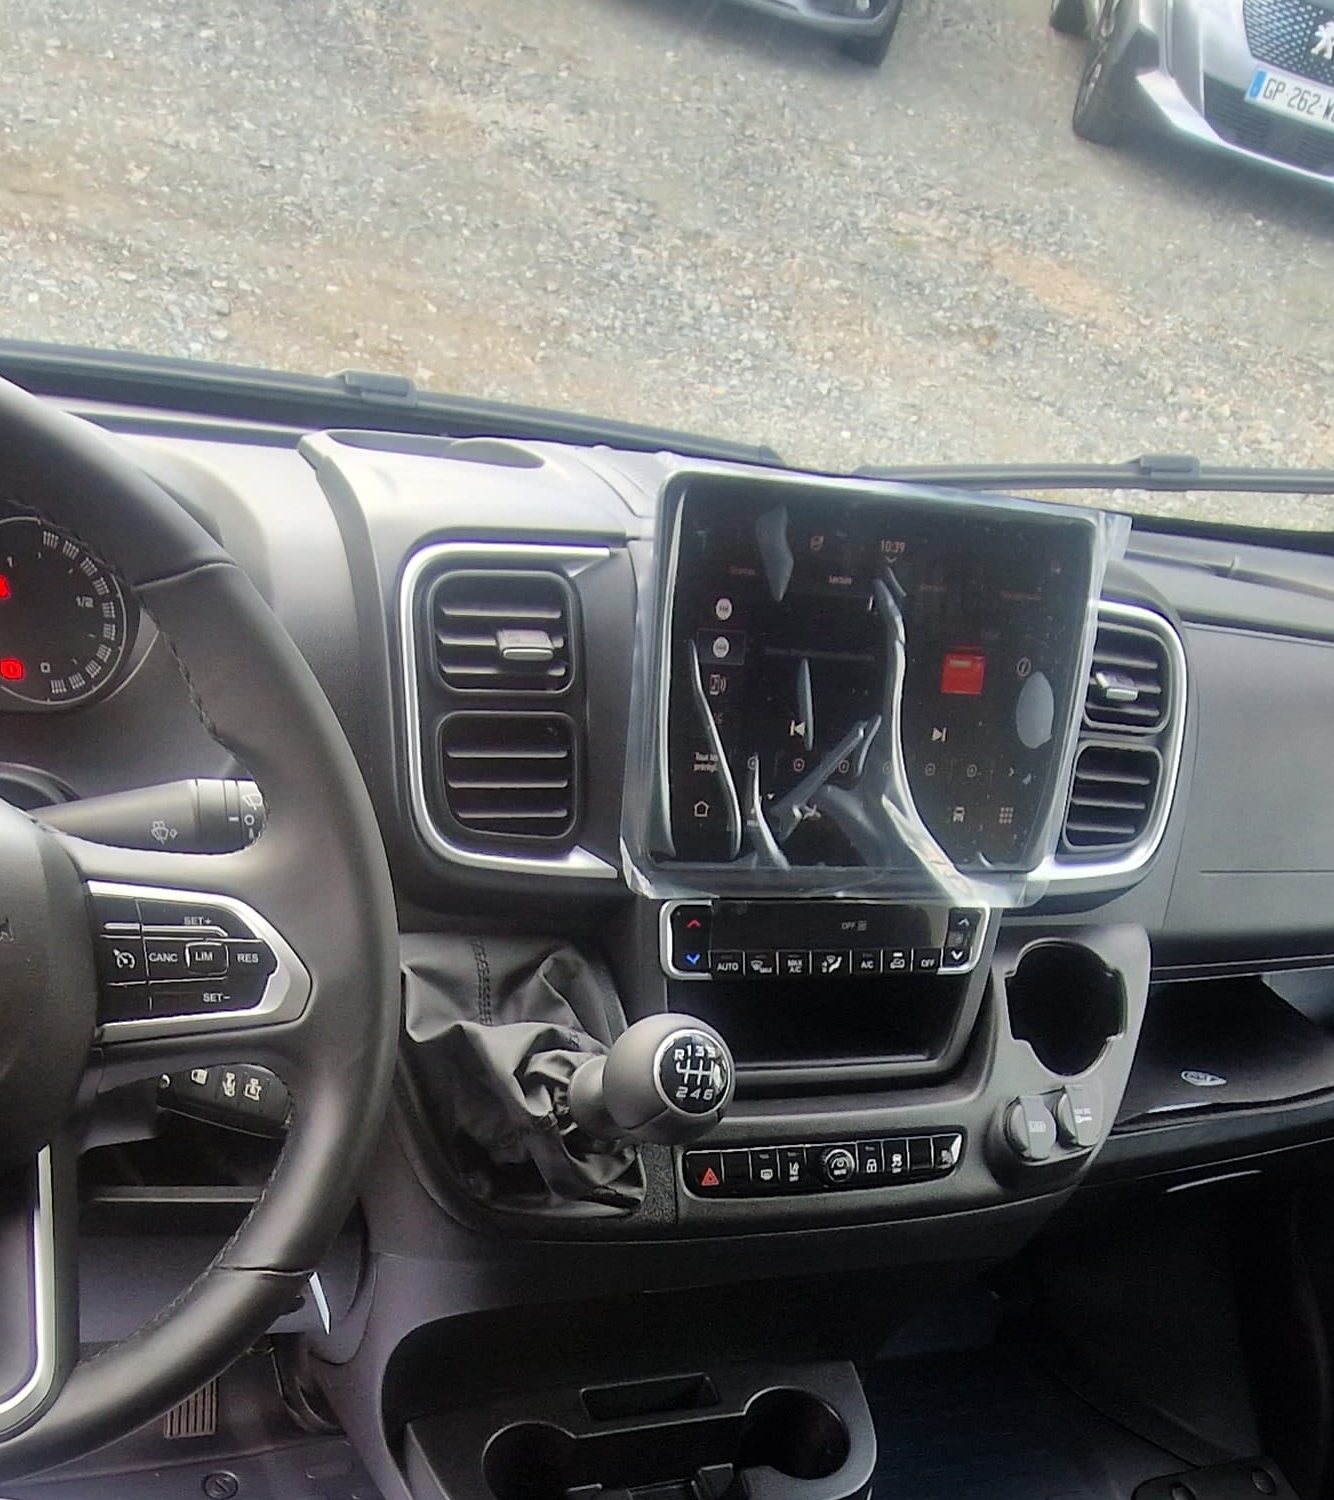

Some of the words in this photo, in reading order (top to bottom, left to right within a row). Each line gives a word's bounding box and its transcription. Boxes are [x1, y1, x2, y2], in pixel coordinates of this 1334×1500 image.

[183, 916, 212, 926] SET+
[148, 952, 179, 963] CANC
[195, 951, 213, 962] LIM
[237, 953, 259, 963] RES
[717, 962, 740, 972] AUTO
[920, 958, 936, 969] OFF
[203, 993, 231, 1003] SET-
[674, 1048, 685, 1061] R
[687, 1044, 692, 1057] 1
[695, 1045, 704, 1057] 3
[675, 1086, 689, 1098] 2
[690, 1088, 702, 1100] 4
[703, 1088, 714, 1101] 6
